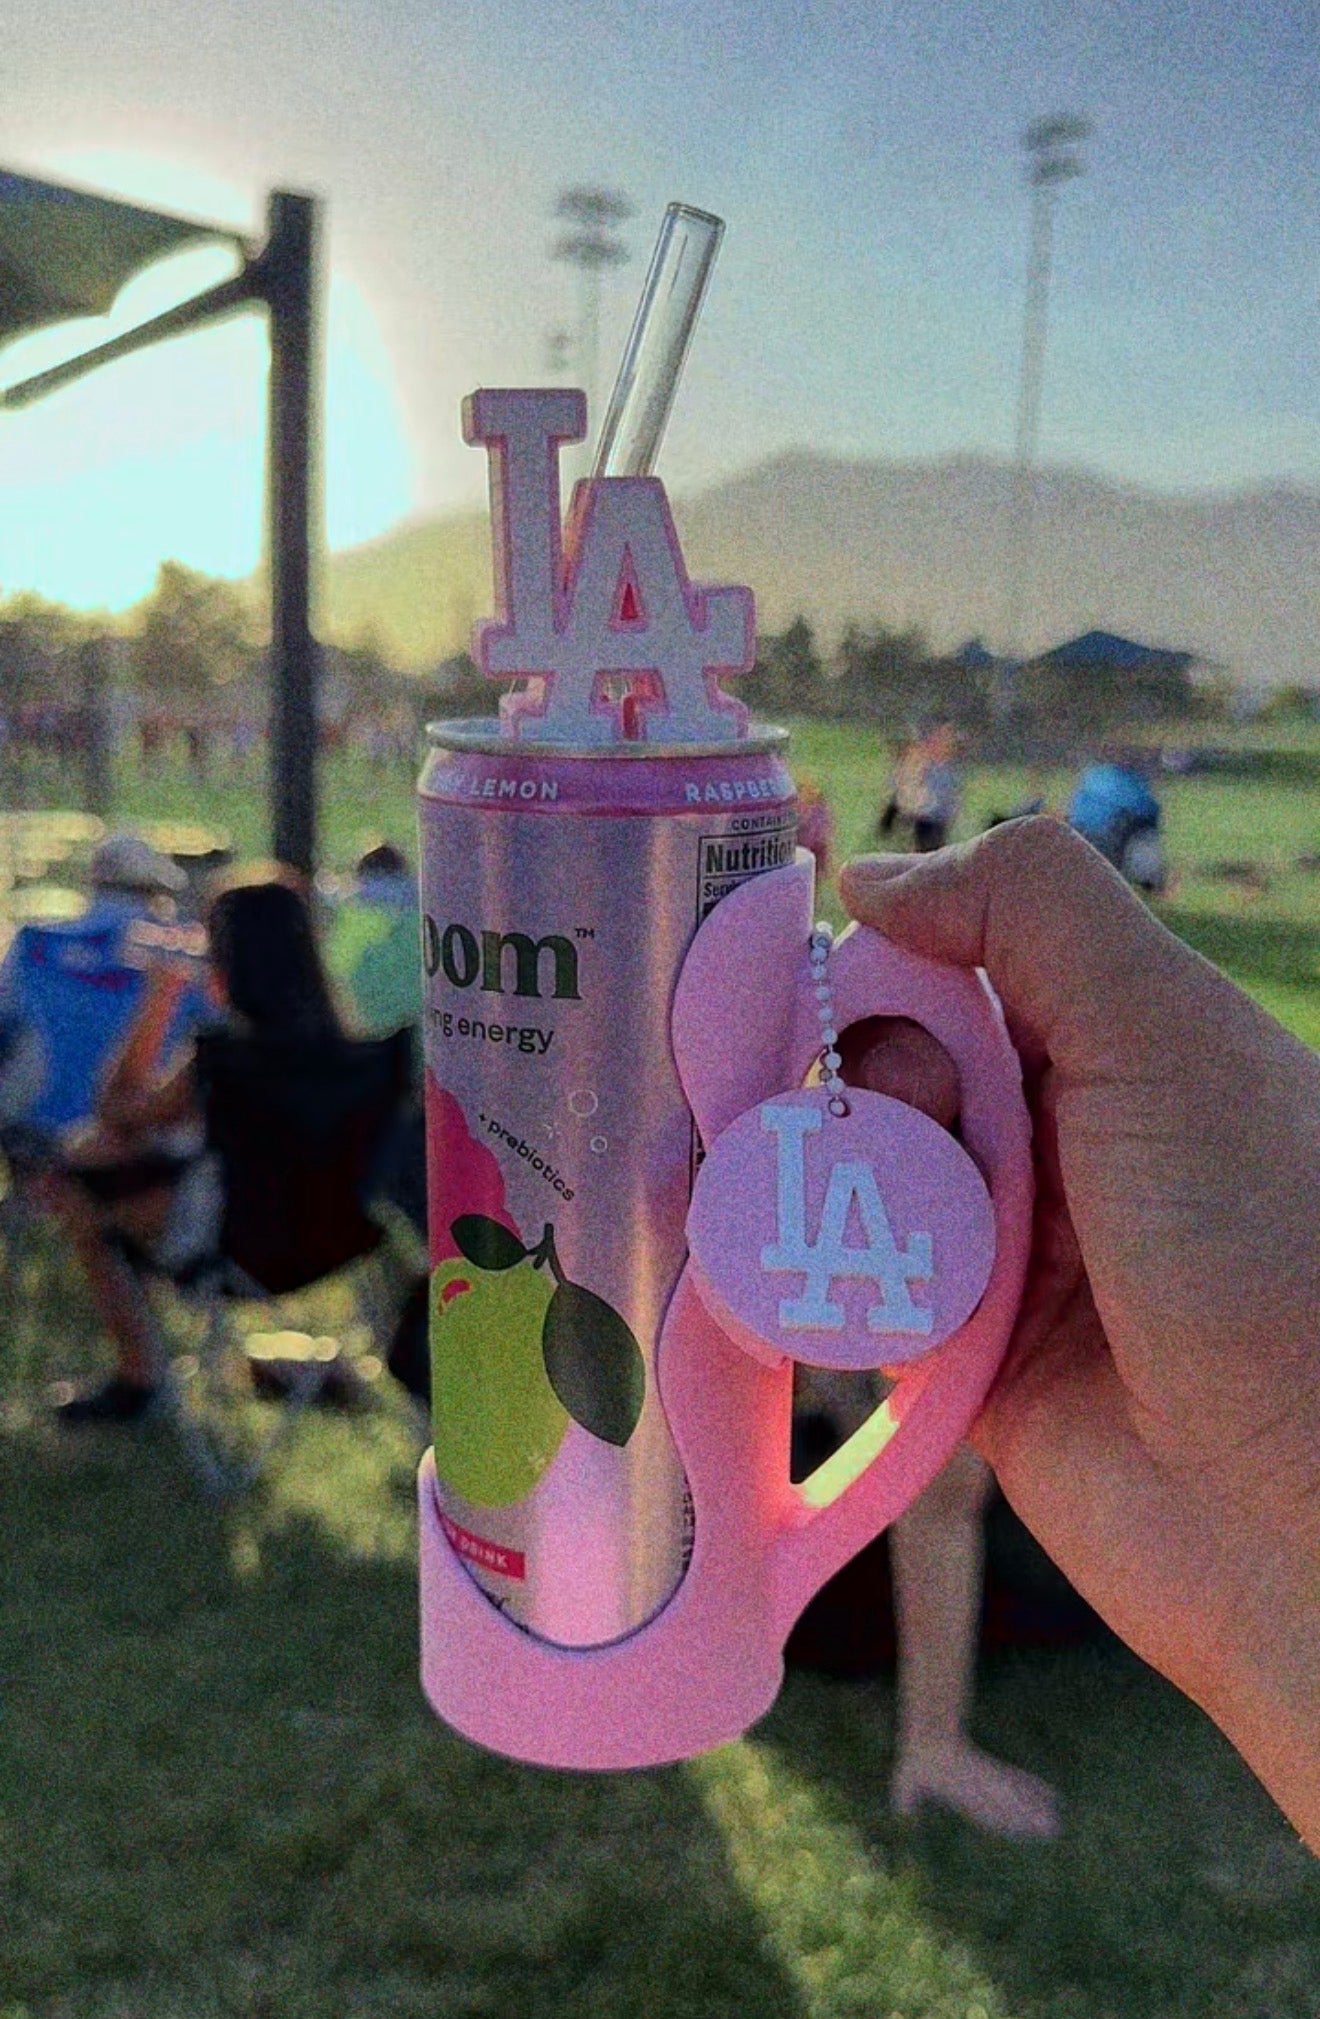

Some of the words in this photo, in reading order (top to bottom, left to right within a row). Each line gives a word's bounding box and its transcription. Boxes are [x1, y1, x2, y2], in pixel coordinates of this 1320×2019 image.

[462, 387, 755, 742] LA
[470, 778, 559, 800] LEMON
[457, 1017, 554, 1055] energy
[487, 1119, 575, 1201] prebiotics
[761, 1106, 933, 1335] LA
[459, 1535, 508, 1568] DRINK
